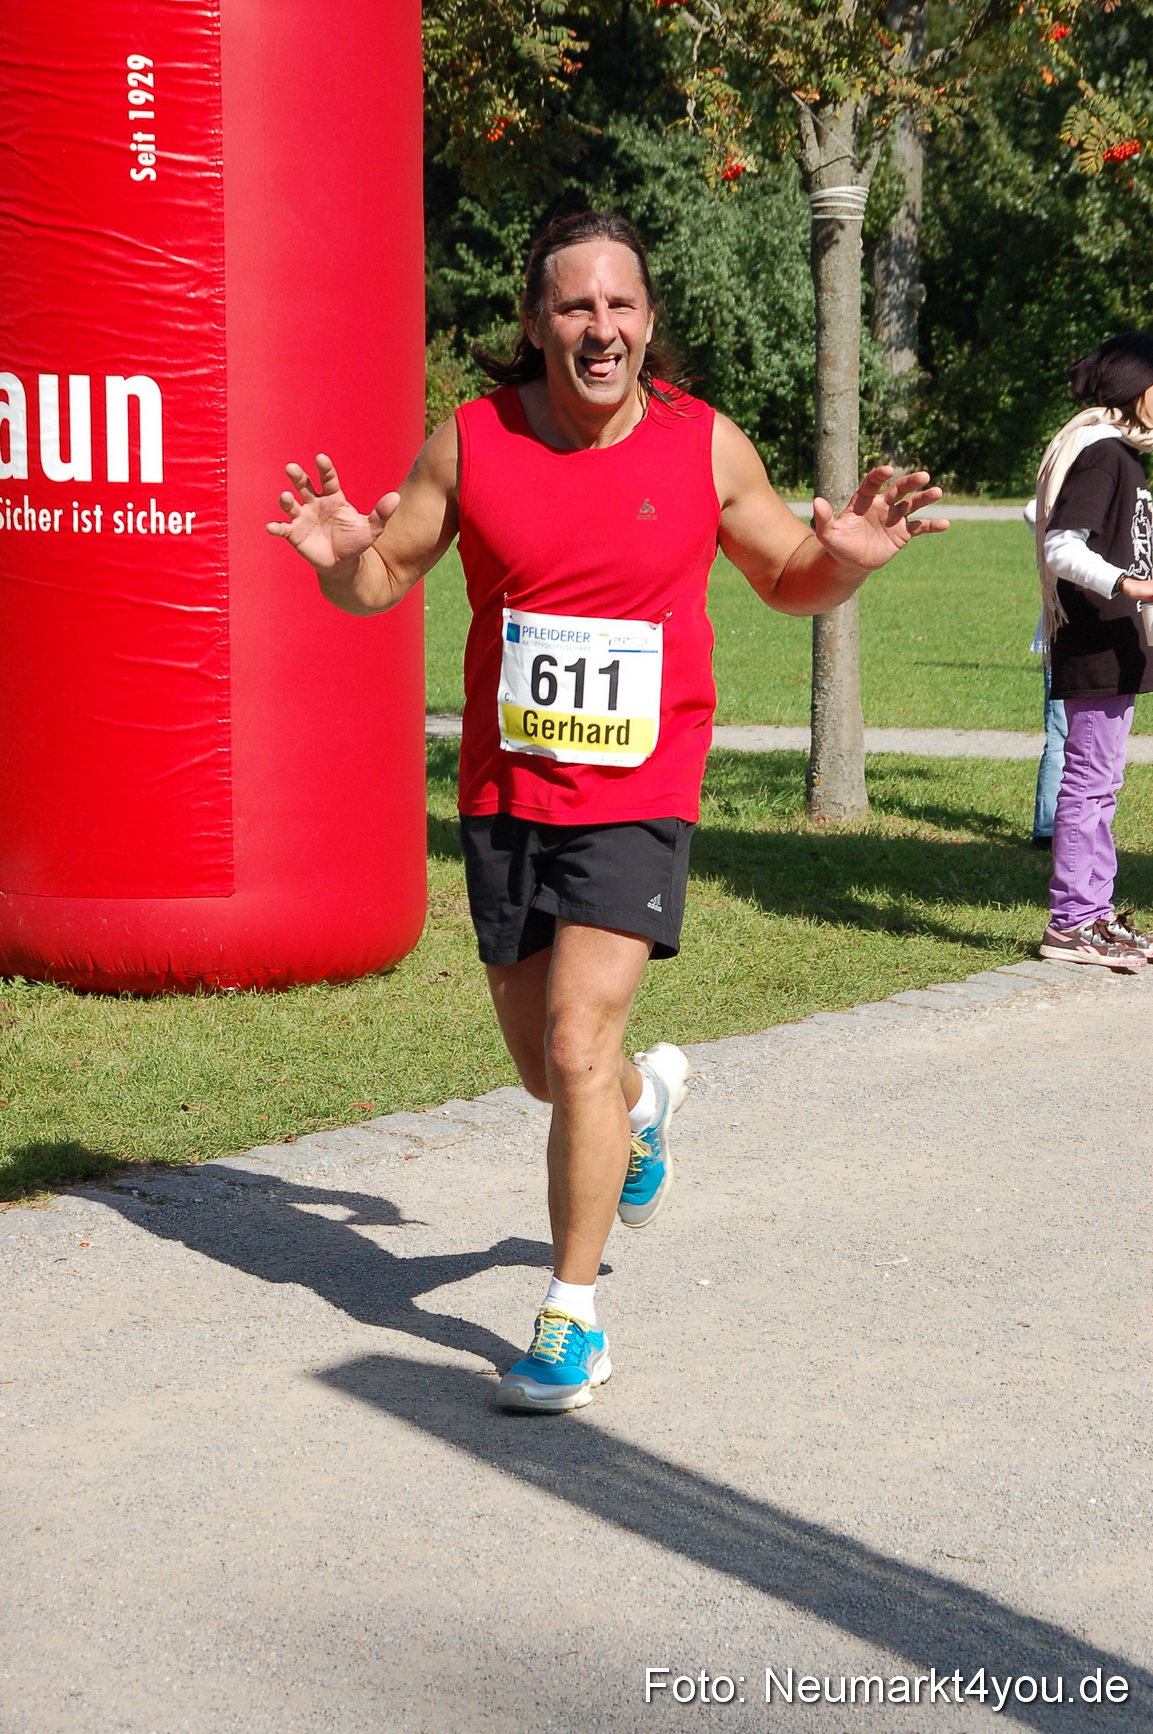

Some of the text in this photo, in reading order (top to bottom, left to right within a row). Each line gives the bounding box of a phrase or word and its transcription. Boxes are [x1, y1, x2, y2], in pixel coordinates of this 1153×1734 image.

[126, 54, 157, 181] Seit 1929
[72, 501, 103, 534] ist
[113, 498, 196, 535] sicher
[522, 626, 591, 644] PFLEIDERER
[530, 654, 620, 711] 611
[523, 710, 630, 746] Gerhard
